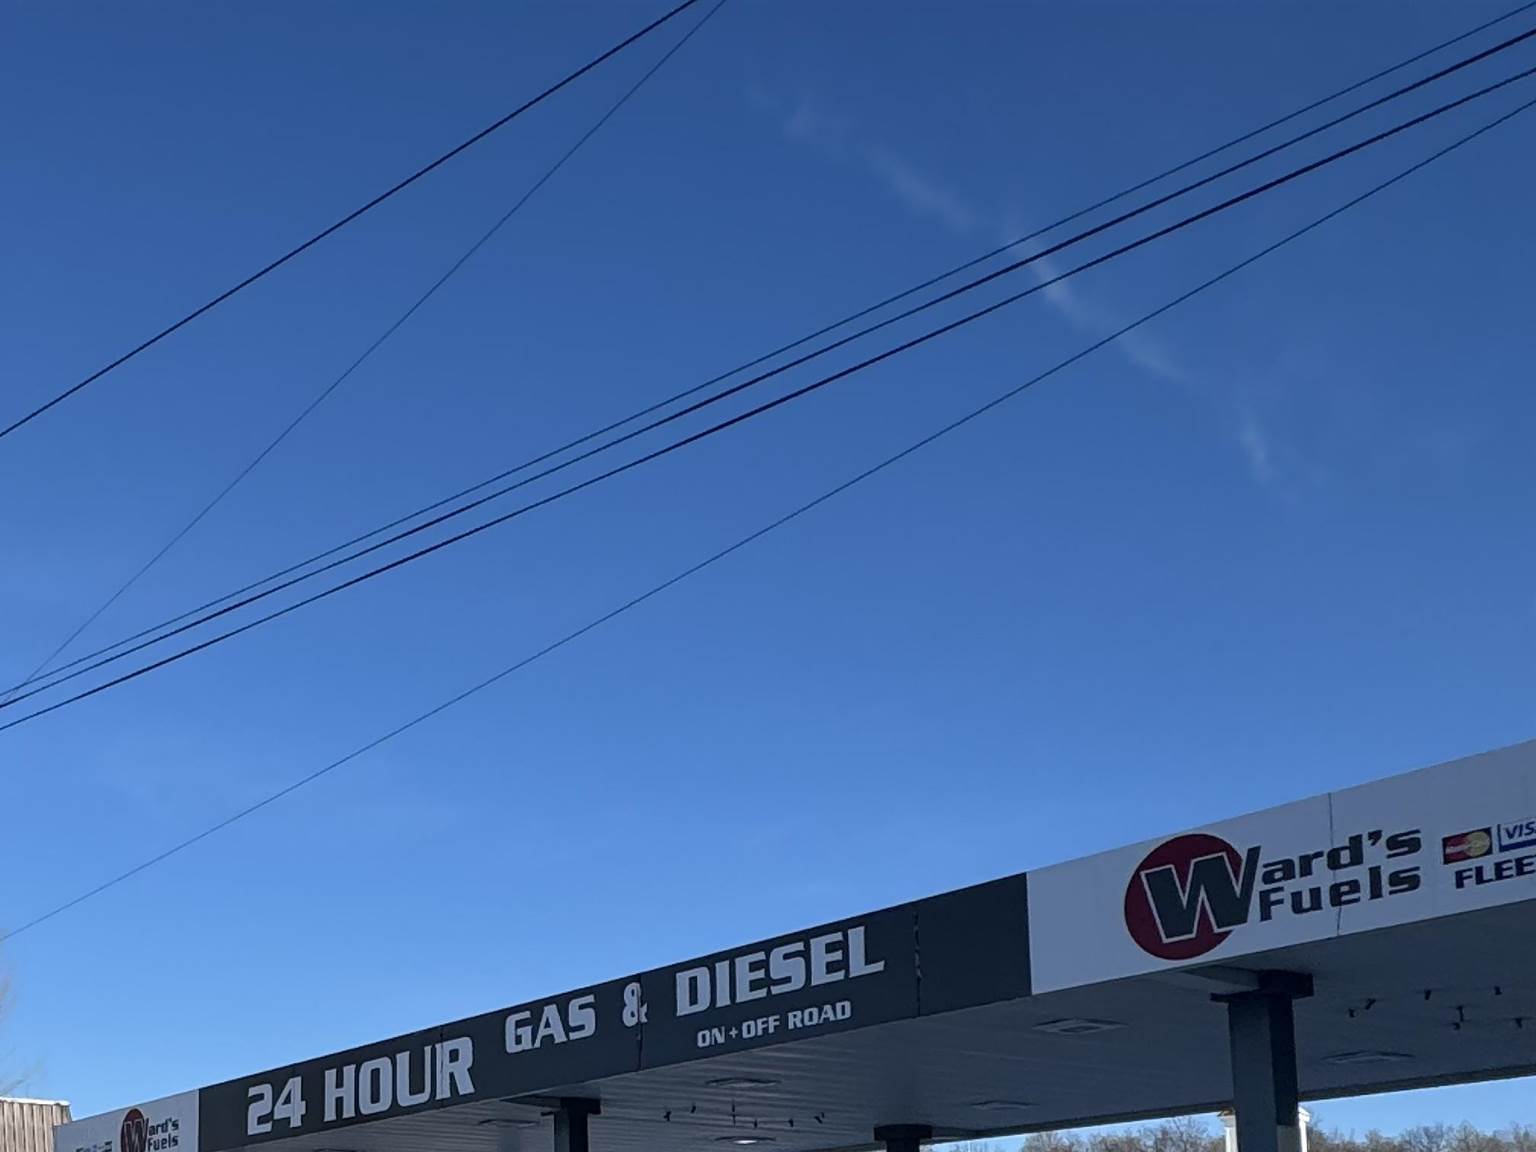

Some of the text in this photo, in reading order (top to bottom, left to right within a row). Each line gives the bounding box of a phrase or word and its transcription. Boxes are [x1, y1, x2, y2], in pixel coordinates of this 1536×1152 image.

[1505, 820, 1536, 840] VIS
[1143, 828, 1422, 942] Ward's
[1259, 866, 1422, 922] Fuels
[1454, 854, 1536, 889] FLEE
[505, 925, 885, 1054] GAS & DIESEL
[696, 1029, 726, 1048] ON
[741, 1015, 780, 1040] OFF
[787, 1000, 852, 1030] ROAD
[247, 1036, 476, 1136] 24 HOUR
[147, 1134, 179, 1152] Fuels
